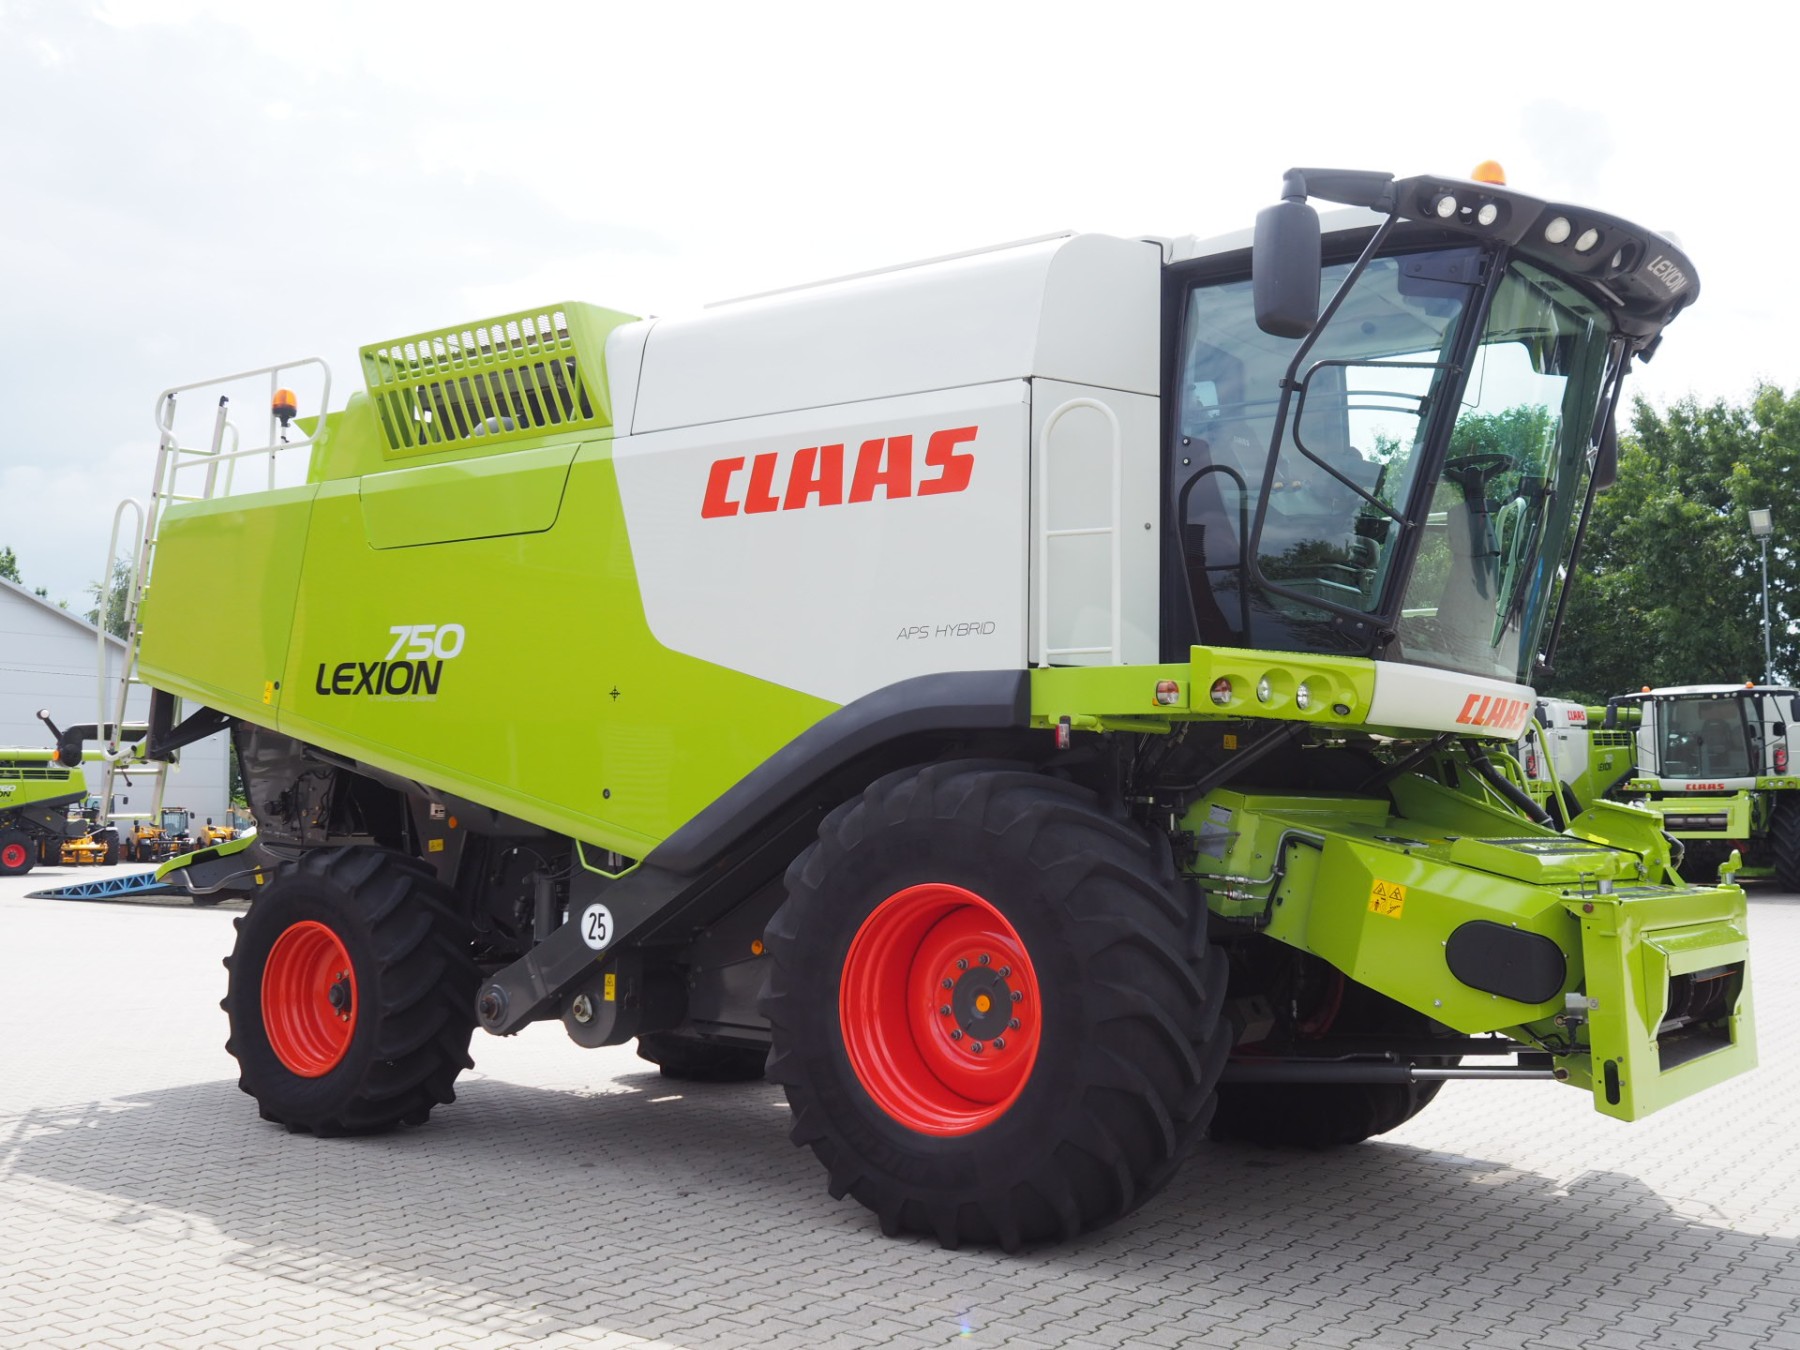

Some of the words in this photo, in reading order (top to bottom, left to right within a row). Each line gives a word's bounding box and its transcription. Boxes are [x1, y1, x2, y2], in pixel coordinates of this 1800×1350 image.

[1647, 255, 1688, 293] LEXION
[701, 425, 979, 519] CLAAS
[385, 623, 466, 660] 750
[896, 625, 930, 640] APS
[935, 621, 996, 637] HYBRID
[315, 660, 443, 695] LEXION
[1456, 693, 1530, 731] CLAAS
[1567, 710, 1585, 721] CLAAS
[1685, 783, 1725, 791] CLAAS
[588, 912, 606, 941] 25
